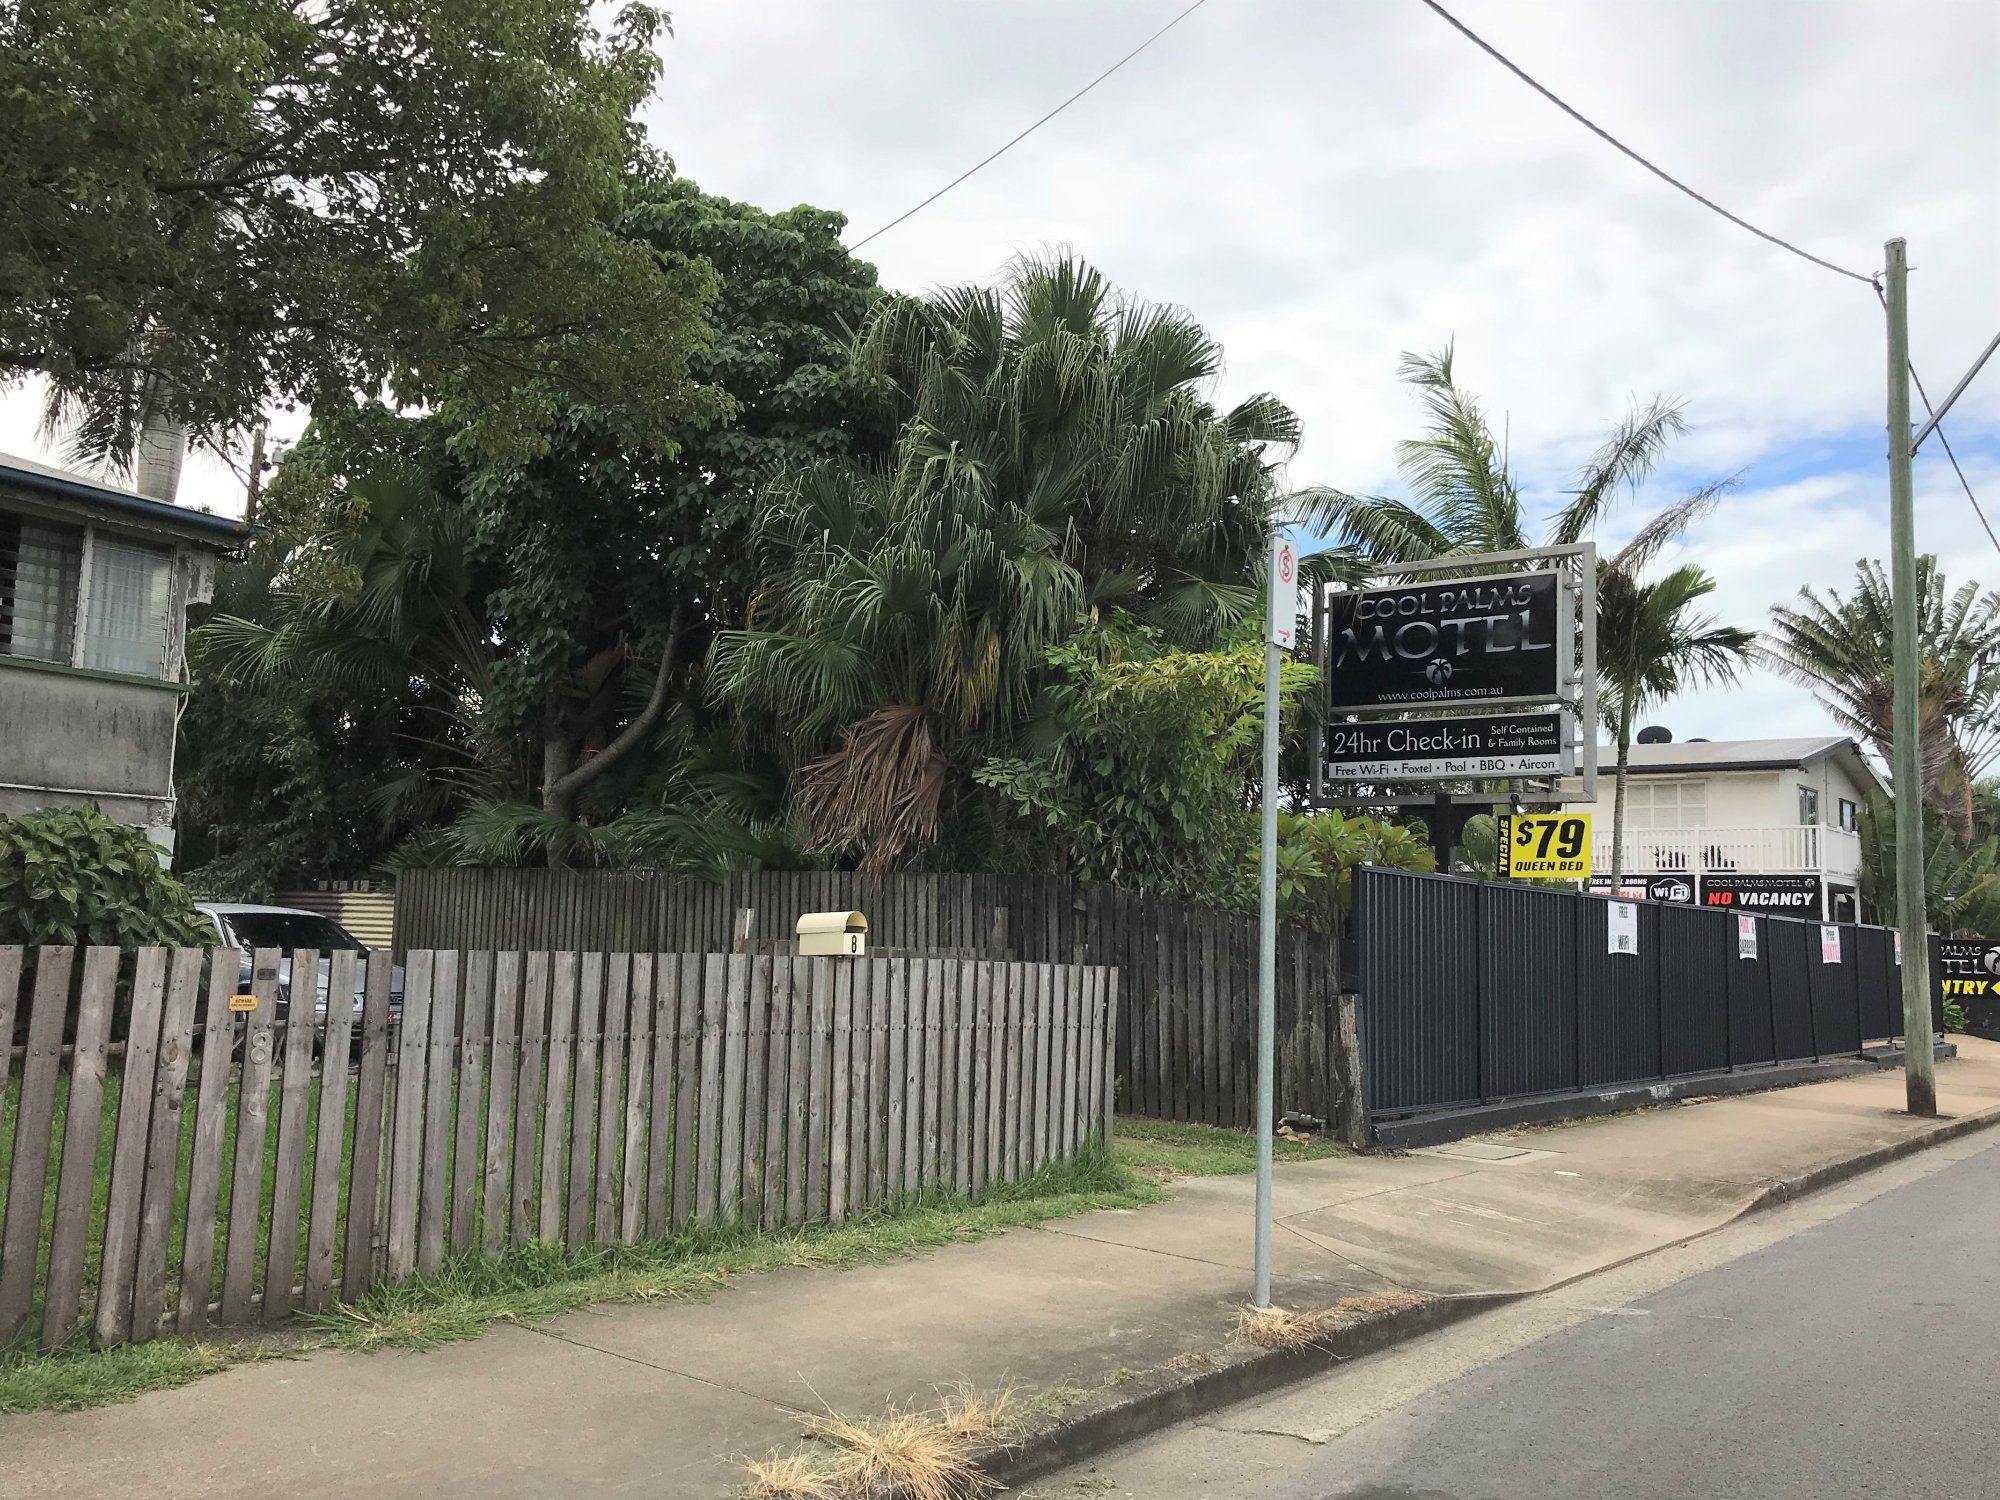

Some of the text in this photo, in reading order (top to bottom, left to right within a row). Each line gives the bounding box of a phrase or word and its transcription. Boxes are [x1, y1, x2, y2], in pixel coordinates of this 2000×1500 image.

[1355, 584, 1531, 620] COOL PALMS
[1336, 609, 1552, 668] MOTEL
[1377, 686, 1504, 701] www.coolpalms.com.au
[1490, 723, 1553, 735] Self Contained
[1333, 728, 1481, 754] 24hr Check-in
[1488, 736, 1557, 749] & Family Rooms
[1335, 758, 1555, 776] Free Wi-Fi Foxtel Pool BBQ Aircon
[1499, 819, 1509, 873] SPECIAL
[1516, 818, 1586, 859] $79
[1515, 861, 1584, 872] QUEEN BED
[1706, 879, 1803, 888] COOL PALMS MOTEL
[1708, 892, 1814, 906] NO VACANCY
[851, 934, 857, 953] 8
[1941, 958, 1987, 974] TEL
[1941, 979, 1989, 995] NTRY
[250, 1031, 274, 1065] 8
